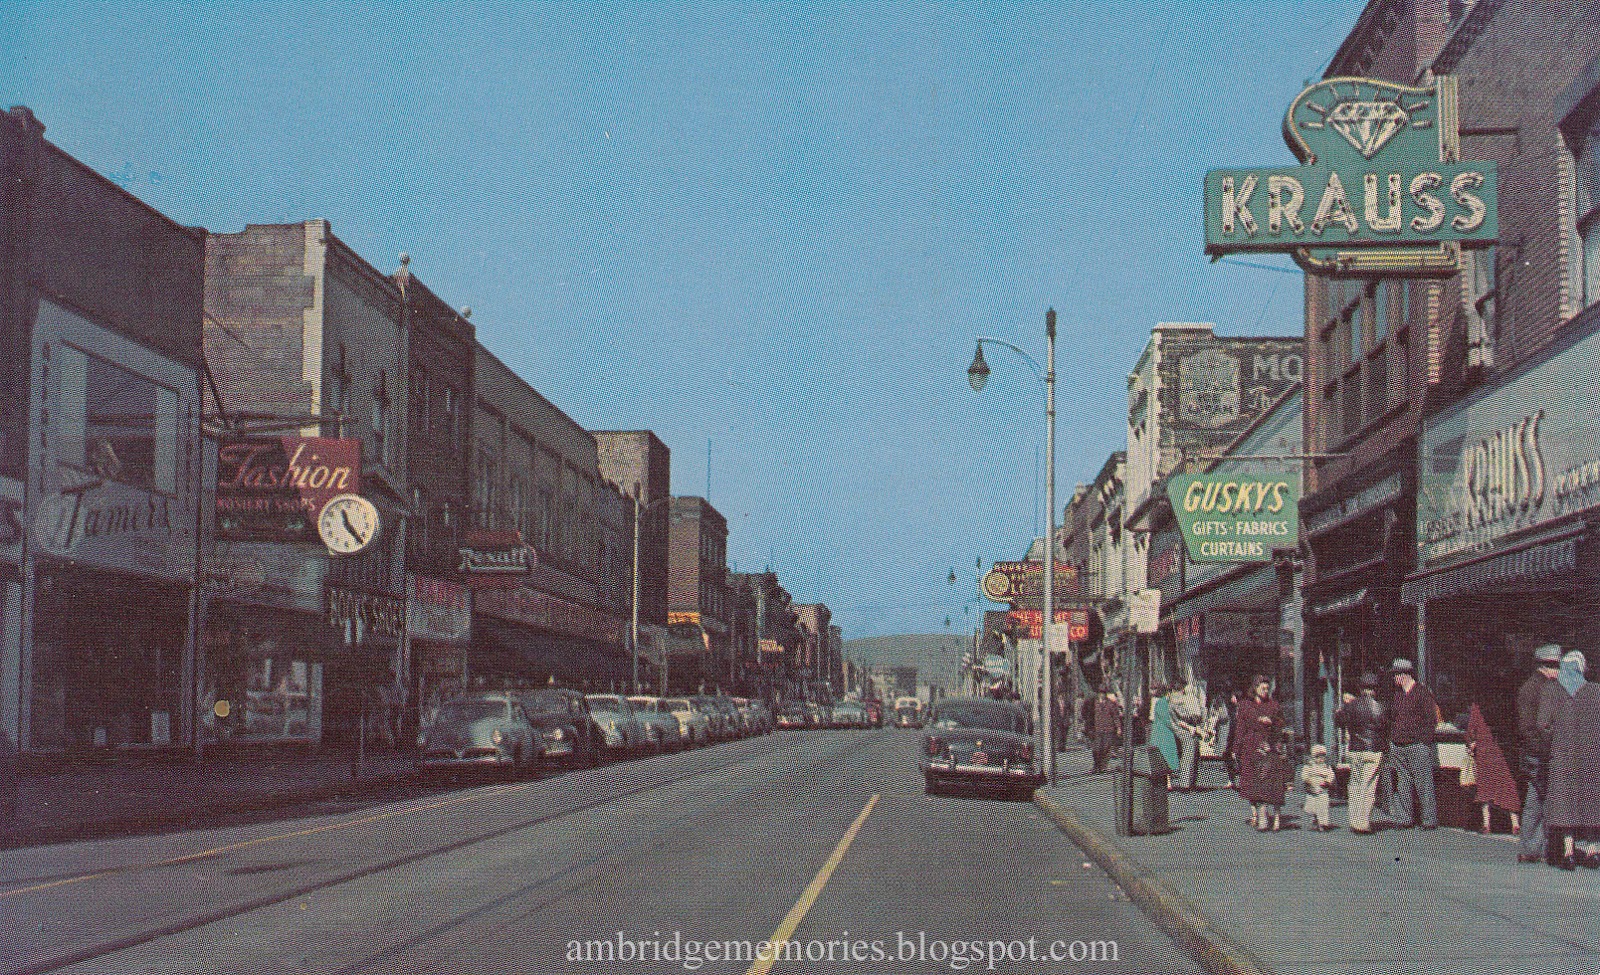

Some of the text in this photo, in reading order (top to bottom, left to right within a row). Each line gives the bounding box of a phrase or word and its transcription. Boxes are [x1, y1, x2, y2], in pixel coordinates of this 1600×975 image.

[1221, 171, 1487, 236] KRAUSS
[219, 442, 350, 489] Fashion
[1463, 411, 1544, 529] KRAUSS
[1183, 480, 1289, 513] GUSKYS
[1192, 520, 1289, 536] GIFTS FABRICS
[458, 547, 527, 570] Rexall
[1200, 541, 1264, 556] CURTAINS
